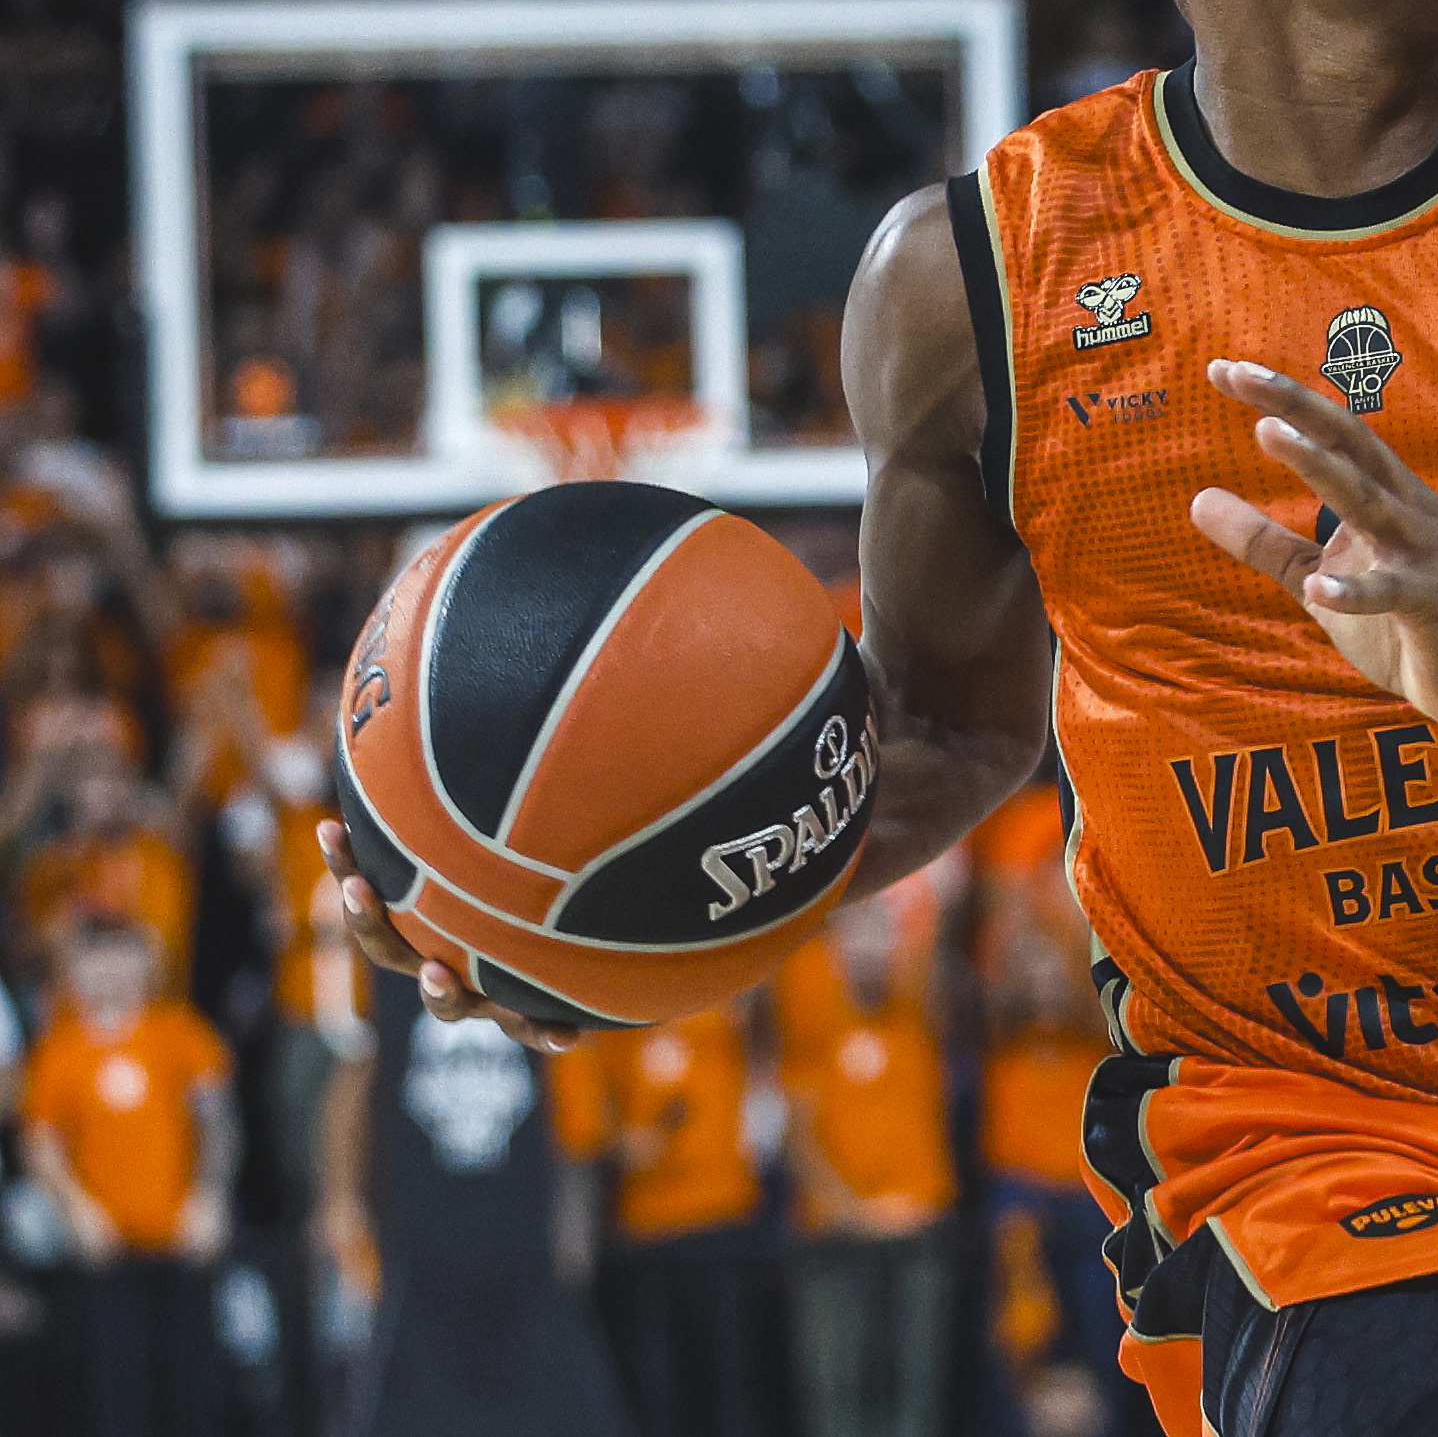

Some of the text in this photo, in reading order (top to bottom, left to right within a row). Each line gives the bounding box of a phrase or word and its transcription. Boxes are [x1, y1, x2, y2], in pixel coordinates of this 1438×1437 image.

[1075, 314, 1150, 350] hummel
[1348, 373, 1382, 397] 40
[1106, 388, 1168, 410] VICKY
